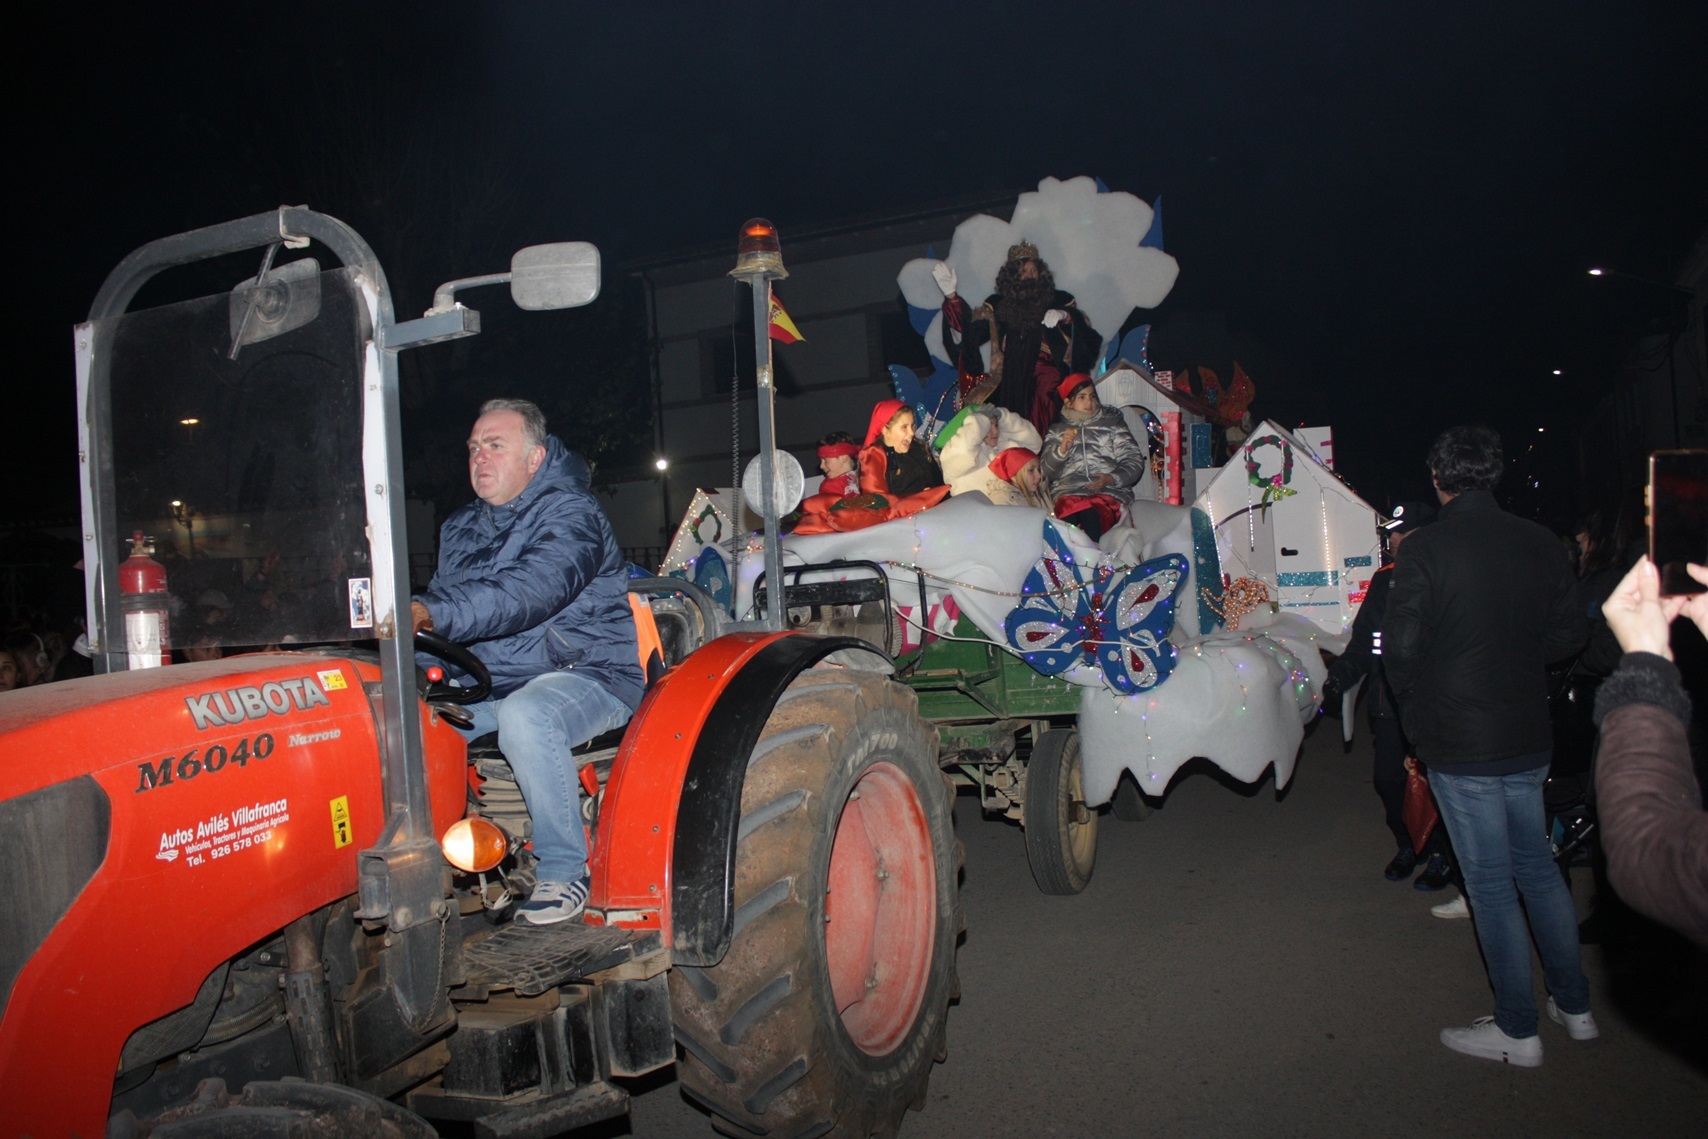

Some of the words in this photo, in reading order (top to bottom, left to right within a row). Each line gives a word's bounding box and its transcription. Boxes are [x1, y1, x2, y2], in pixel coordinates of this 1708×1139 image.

[185, 676, 330, 730] KUBOTA
[134, 733, 275, 794] M6040
[288, 728, 341, 747] Narrow
[847, 732, 898, 777] TM700
[160, 828, 194, 851] Autos
[197, 813, 229, 839] Avilés
[232, 798, 287, 827] Villafranca
[186, 853, 206, 867] Tel.
[211, 844, 231, 859] 926
[233, 836, 252, 852] 578
[253, 830, 272, 844] 033
[212, 832, 236, 846] Tractores
[237, 830, 241, 839] y
[241, 820, 269, 836] Maquinaria
